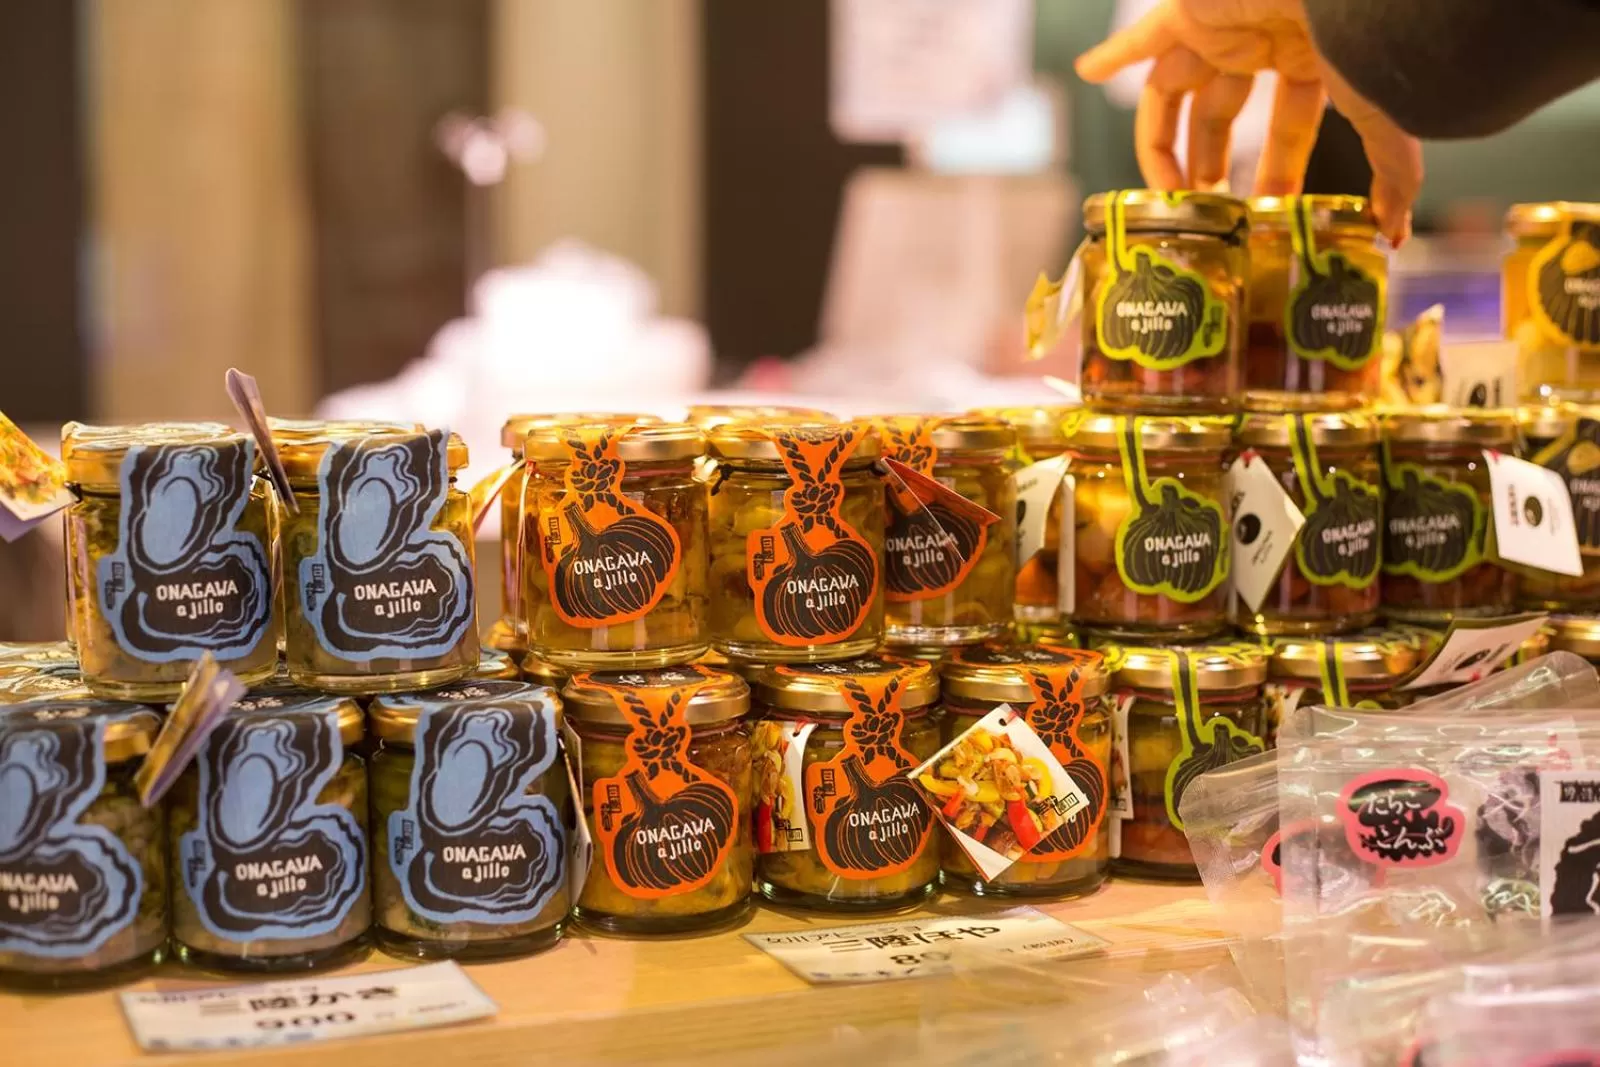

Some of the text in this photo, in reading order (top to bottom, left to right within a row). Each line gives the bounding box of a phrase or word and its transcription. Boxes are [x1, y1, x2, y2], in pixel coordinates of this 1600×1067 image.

[1116, 300, 1188, 318] ONAGAWA
[1144, 533, 1211, 552] ONAGAWA
[573, 550, 652, 575] ONAGAWA
[155, 579, 239, 601] ONAGAWA
[353, 578, 437, 601] ONAGAWA
[786, 574, 860, 595] ONAGAWA
[1365, 789, 1421, 815] たらこ
[849, 802, 921, 827] ONAGAWA
[636, 817, 716, 845] ONAGAWA
[1377, 825, 1445, 850] こんぶ
[442, 843, 527, 863] ONAGAWA
[234, 854, 323, 881] ONAGAWA
[0, 872, 79, 893] NAGAWA
